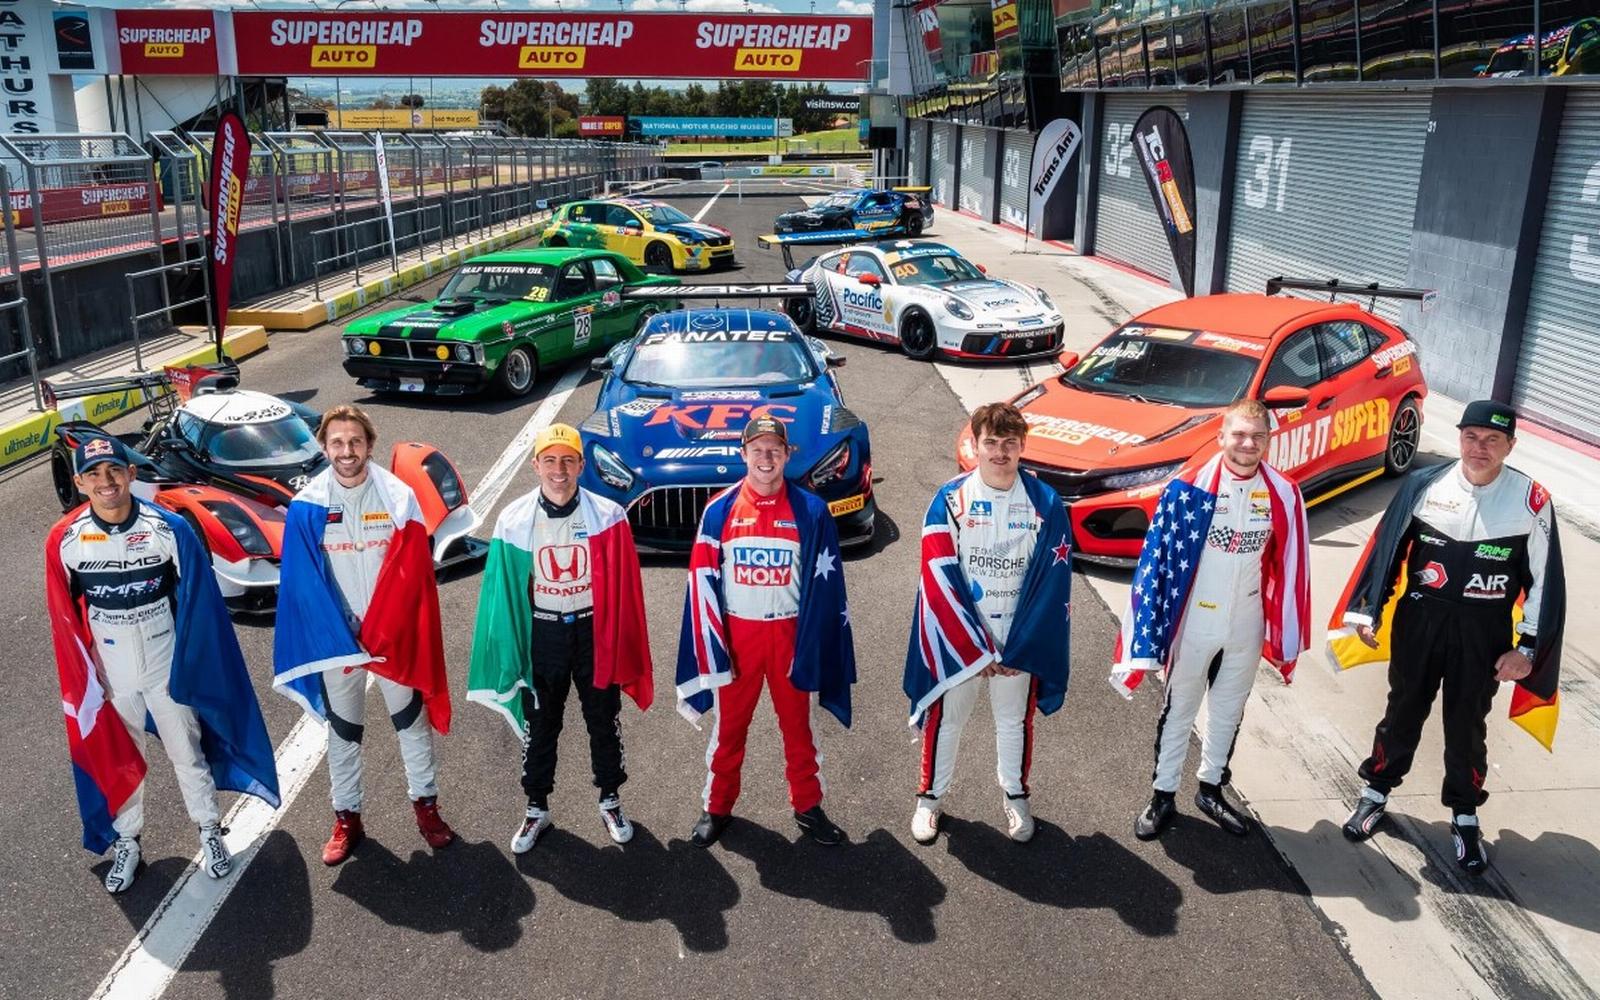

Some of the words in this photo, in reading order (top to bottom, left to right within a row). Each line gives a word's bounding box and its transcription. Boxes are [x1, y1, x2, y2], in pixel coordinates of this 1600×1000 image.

[120, 27, 211, 44] SUPERCHEAP
[270, 18, 423, 46] SUPERCHEAP
[479, 20, 634, 47] SUPERCHEAP
[696, 21, 851, 50] SUPERCHEAP
[318, 50, 369, 62] AUTO
[525, 51, 578, 64] AUTO
[742, 53, 794, 66] AUTO
[642, 122, 680, 130] NATIONAL
[1428, 121, 1437, 133] 31
[1105, 123, 1133, 178] 32
[1004, 148, 1020, 188] 33
[1034, 156, 1060, 197] Trans
[1055, 131, 1075, 160] Am
[1245, 135, 1292, 212] 31
[81, 186, 146, 205] SUPERCHEAP
[213, 122, 238, 265] SUPERCHEAP
[104, 201, 128, 211] AUTO
[227, 181, 238, 226] AUTO
[484, 266, 526, 274] WESTERN
[527, 267, 543, 275] OIL
[895, 263, 918, 278] 40
[529, 286, 548, 298] 28
[690, 285, 808, 294] AMG
[844, 287, 883, 310] Pacific
[576, 315, 591, 338] 28
[645, 330, 788, 345] FANATEC
[1091, 345, 1146, 360] Bathurst
[1371, 339, 1418, 370] SUPERCHEAP
[92, 398, 121, 418] ultimate
[643, 404, 797, 429] KFC
[1036, 427, 1082, 442] AUTO
[1311, 415, 1332, 461] IT
[1330, 397, 1391, 451] SUPER
[5, 431, 41, 456] ultimate
[1235, 530, 1271, 540] ROBERT
[736, 550, 790, 568] LIQUI
[1478, 544, 1512, 557] PRIME
[103, 555, 162, 570] AMG
[969, 554, 1025, 570] PORSCHE
[737, 568, 790, 585] MOLY
[968, 567, 987, 577] NEW
[1465, 573, 1510, 591] AIR
